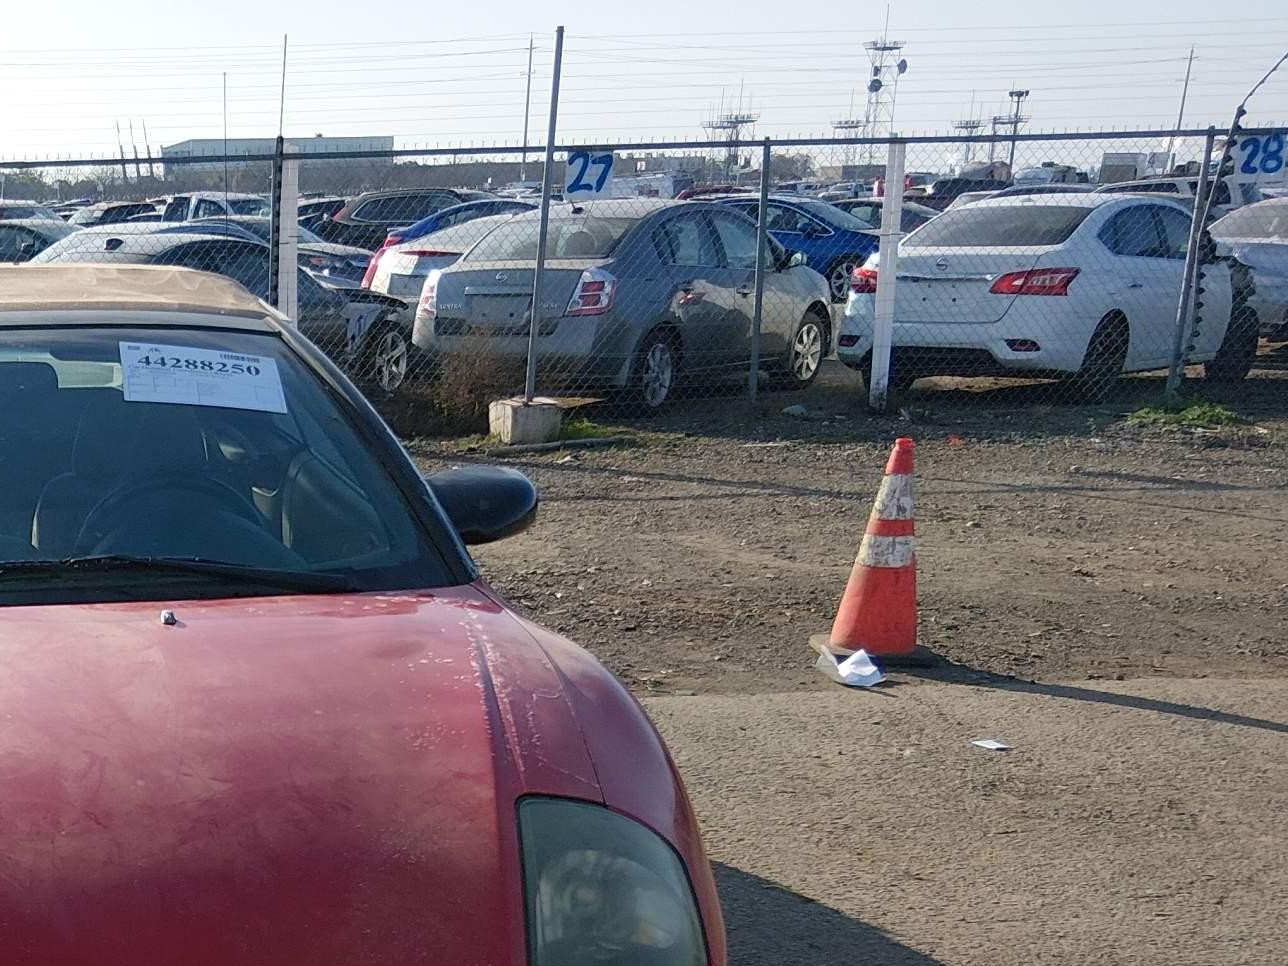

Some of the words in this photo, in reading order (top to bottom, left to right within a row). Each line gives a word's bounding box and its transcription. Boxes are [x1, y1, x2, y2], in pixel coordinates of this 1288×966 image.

[566, 150, 614, 194] 27
[1239, 133, 1284, 174] 28
[137, 355, 261, 377] 44288250
